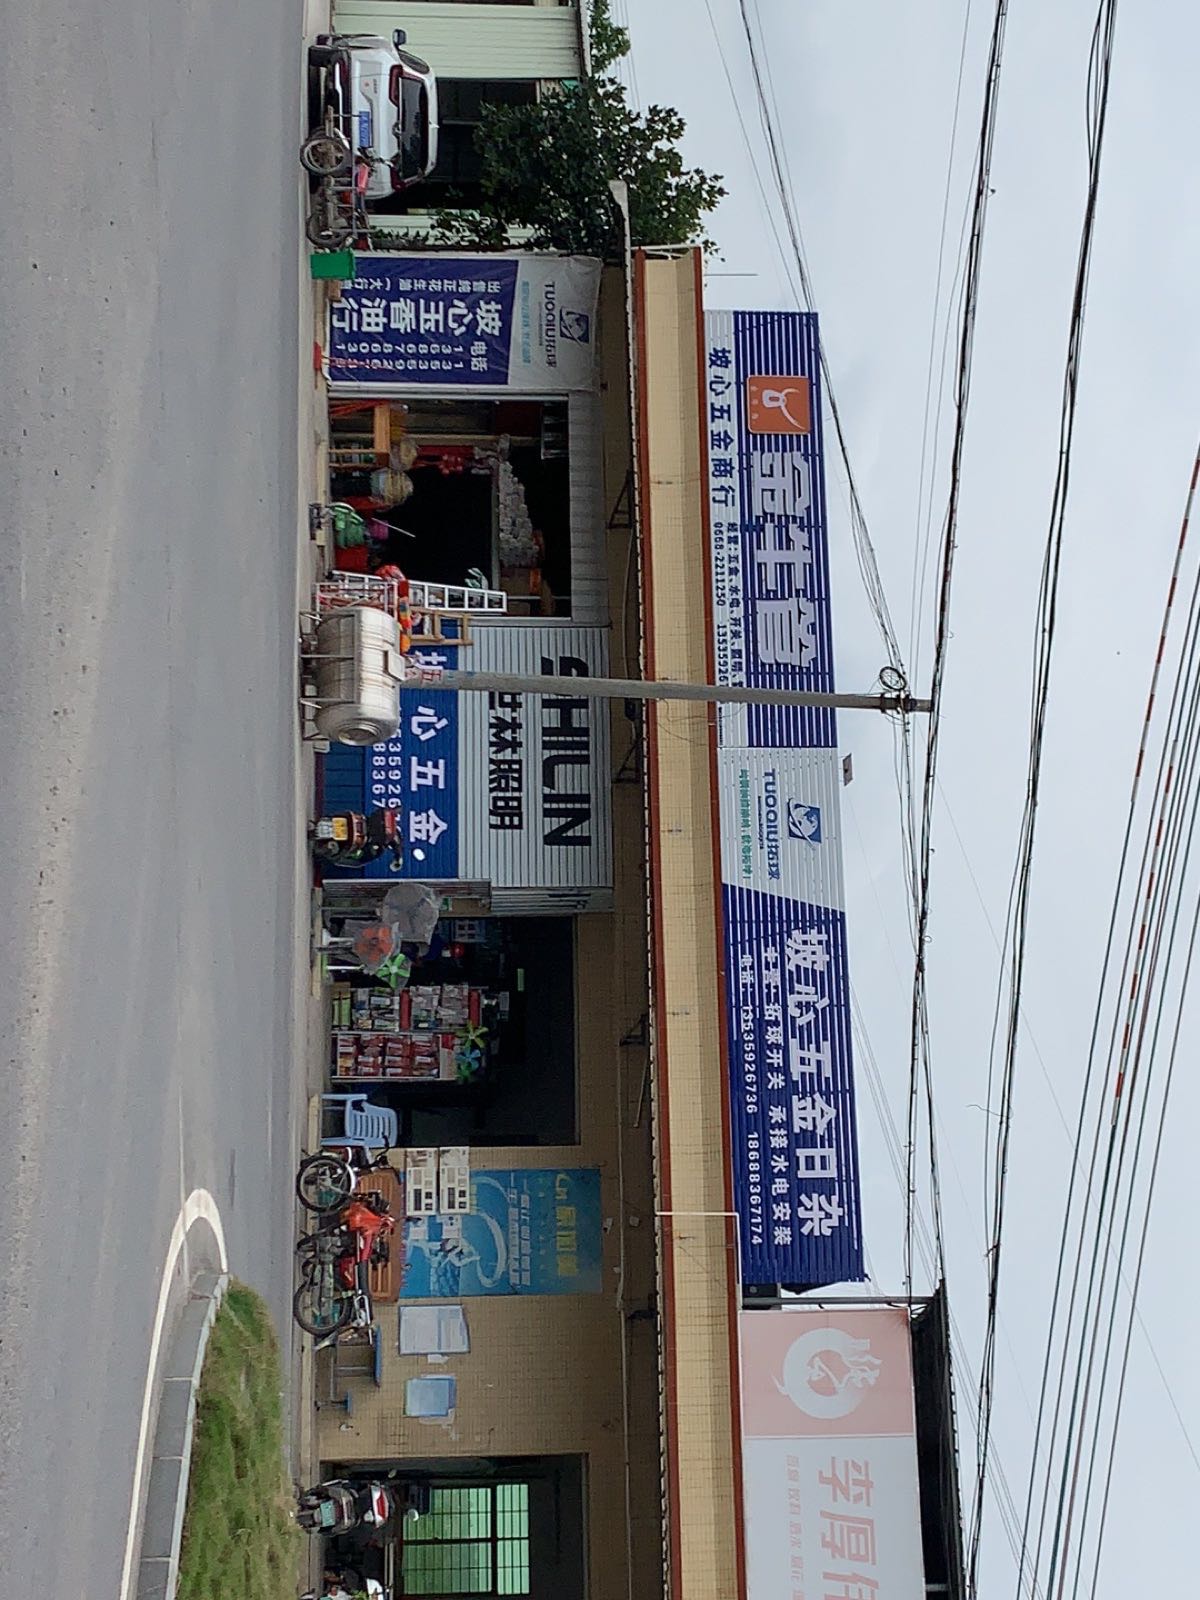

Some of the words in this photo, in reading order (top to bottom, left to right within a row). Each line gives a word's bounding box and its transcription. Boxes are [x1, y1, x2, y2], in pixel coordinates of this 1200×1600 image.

[332, 297, 502, 336] 坡心玉香油行
[470, 341, 487, 372] 电话
[709, 347, 735, 508] 坡心五金商行
[713, 522, 726, 607] 0668-2211250
[752, 451, 817, 668] 金牛管
[741, 1005, 758, 1114] 13535926736
[785, 929, 844, 1237] 坡心五金日杂
[748, 1132, 763, 1246] 18688367174
[768, 1105, 792, 1246] 承接水电安装
